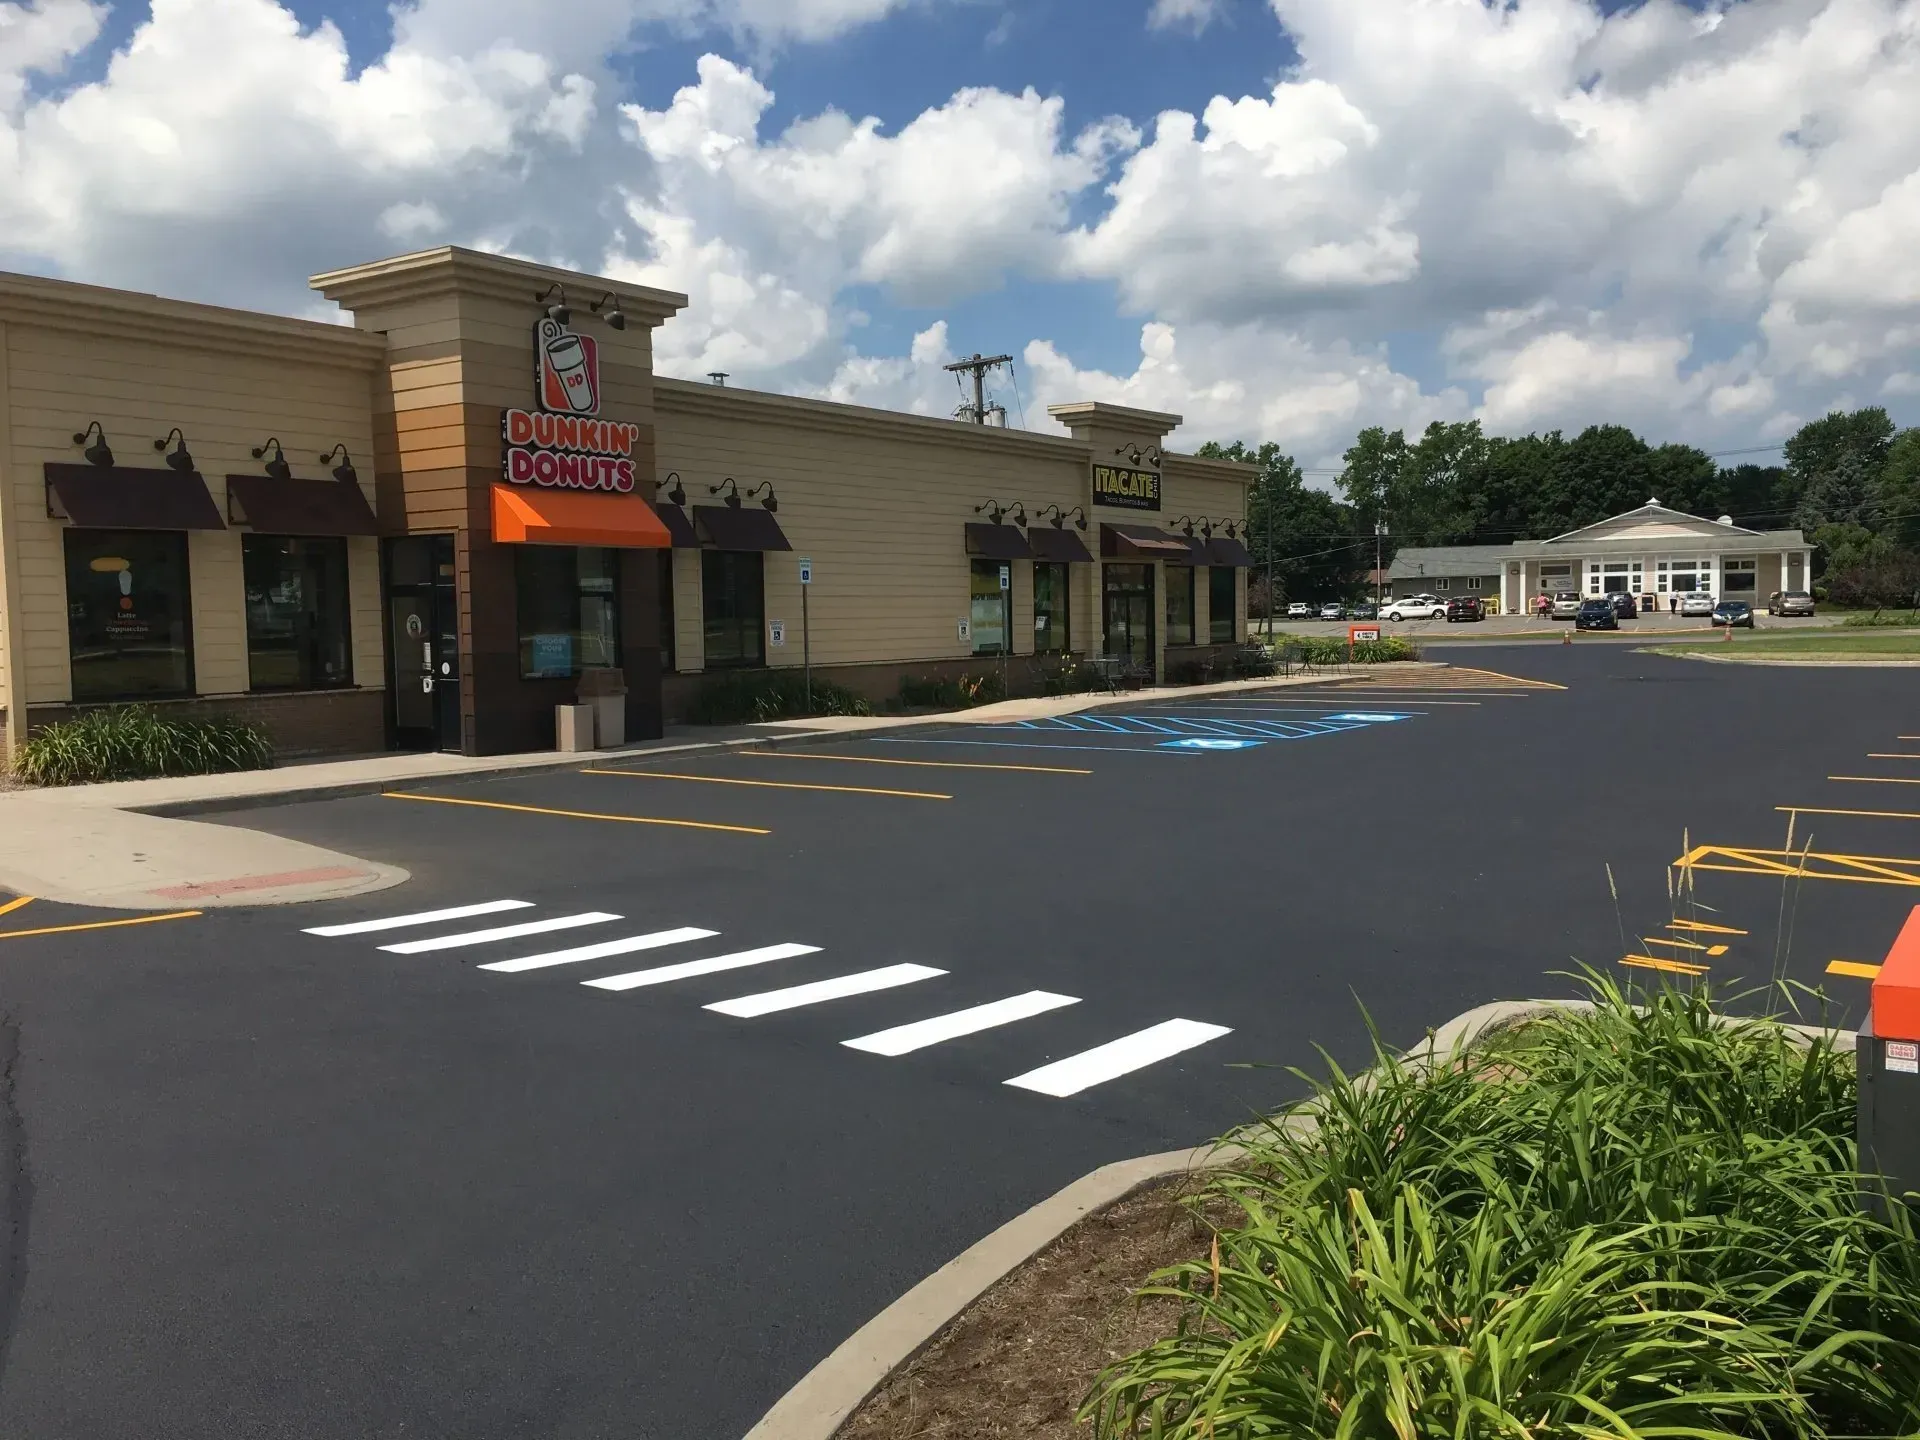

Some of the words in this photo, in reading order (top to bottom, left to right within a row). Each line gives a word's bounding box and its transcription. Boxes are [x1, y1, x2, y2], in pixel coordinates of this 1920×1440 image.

[566, 373, 583, 388] DD
[508, 409, 638, 456] DUNKIN'
[509, 449, 635, 491] DONUTS
[1096, 467, 1153, 498] ITACATE
[106, 625, 149, 633] Cappuccino
